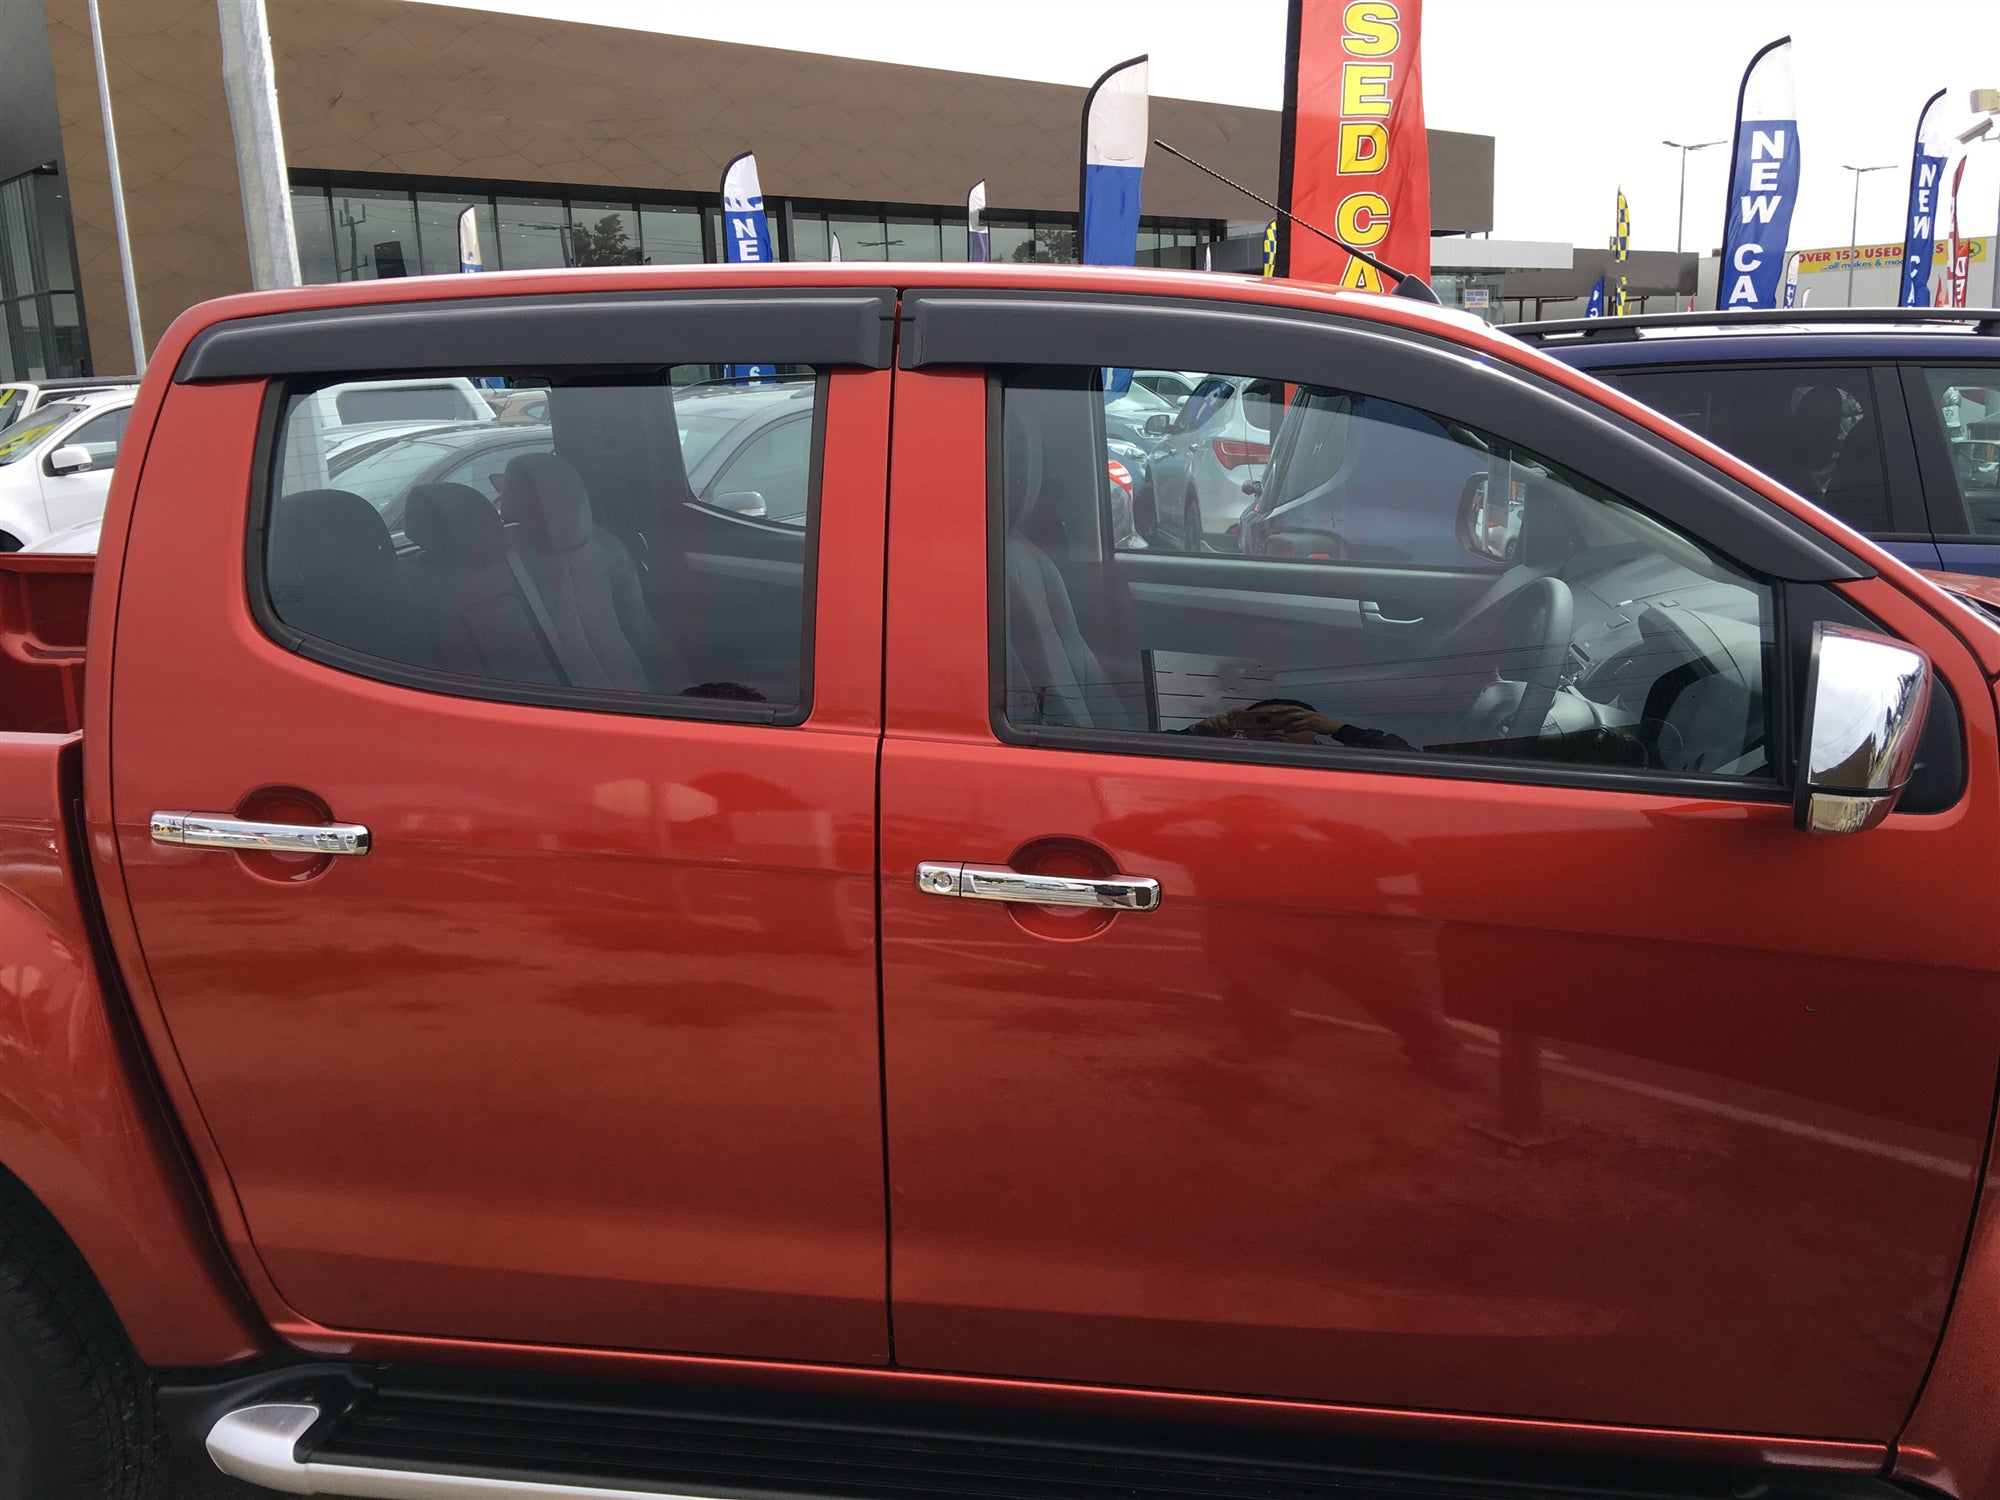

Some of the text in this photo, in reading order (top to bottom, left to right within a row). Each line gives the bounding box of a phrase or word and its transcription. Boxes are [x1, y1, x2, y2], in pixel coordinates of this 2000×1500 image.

[1337, 0, 1400, 176] SED
[1728, 130, 1785, 309] NEW CA
[1798, 246, 1903, 263] OVER 150 USED
[1907, 163, 1937, 307] NEW CA
[1784, 286, 1795, 308] HY
